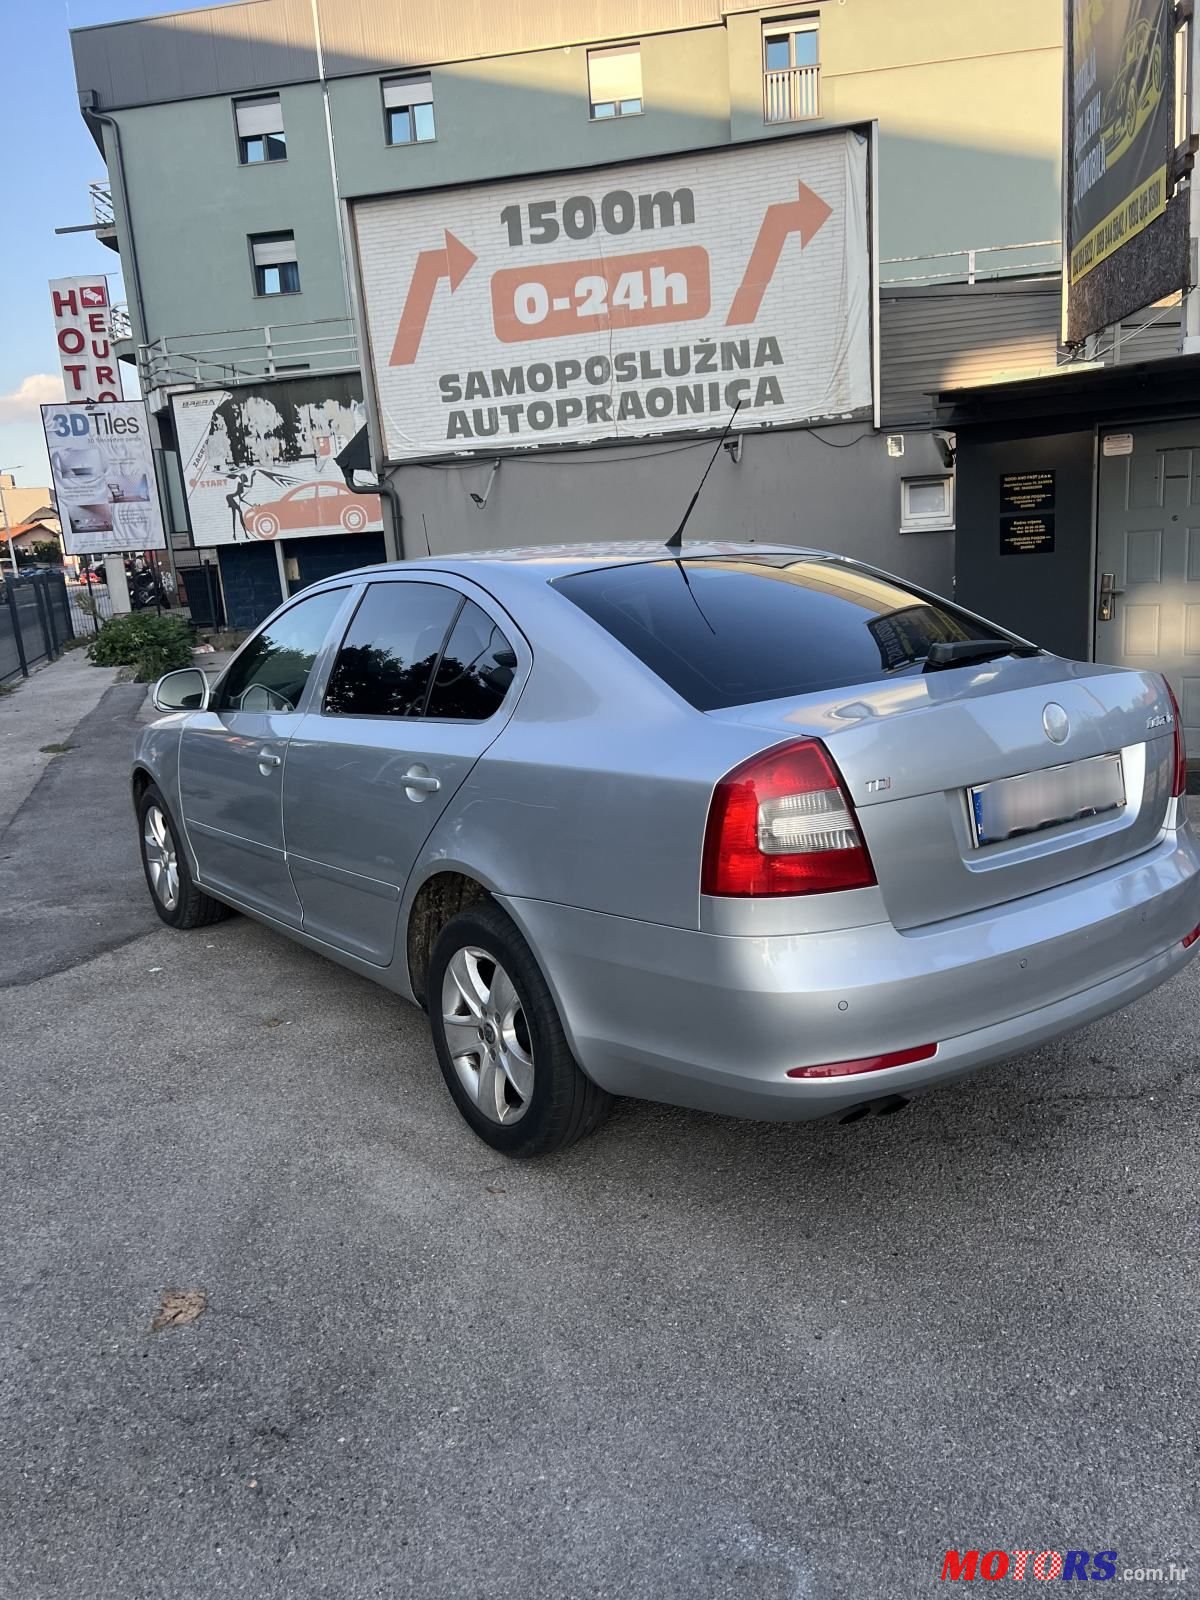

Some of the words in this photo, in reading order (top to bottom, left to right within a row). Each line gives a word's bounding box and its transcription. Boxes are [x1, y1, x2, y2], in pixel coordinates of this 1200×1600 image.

[500, 187, 696, 246] 1500m
[513, 266, 688, 326] 0-24h
[52, 290, 90, 403] HOT
[438, 336, 785, 403] SAMOPOSLUŽNA
[446, 375, 785, 440] AUTOPRAONICA
[200, 479, 228, 488] START
